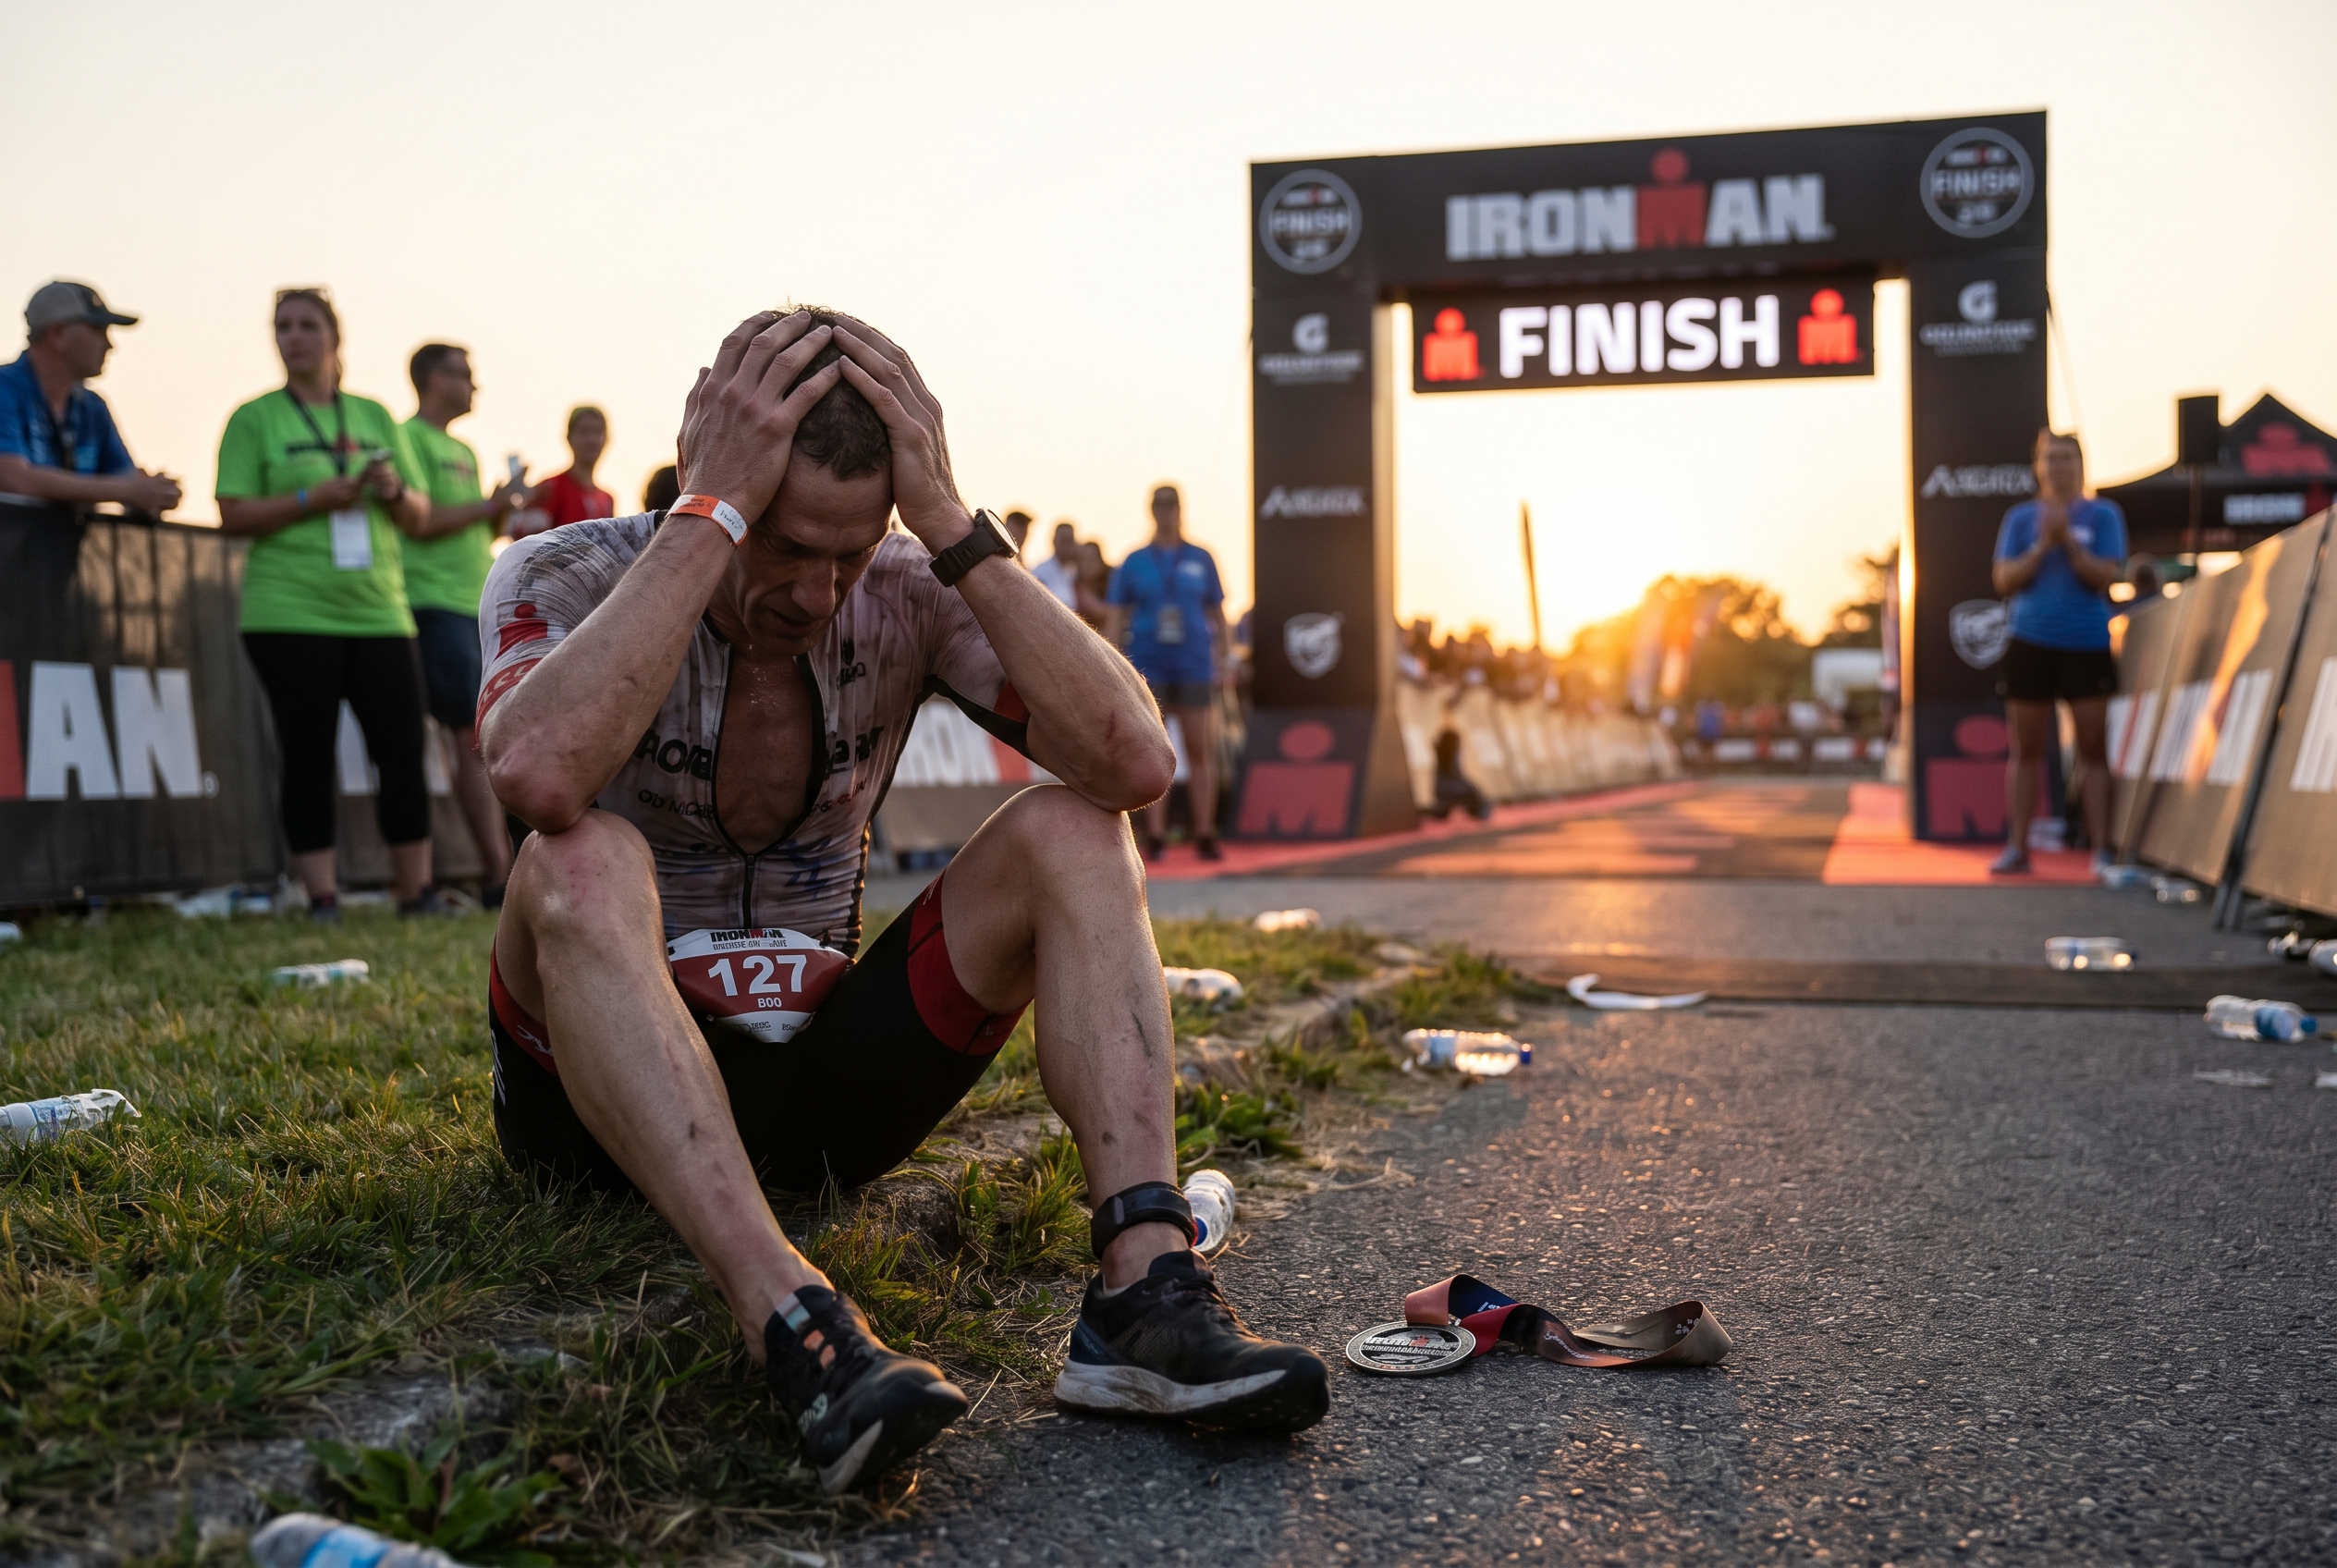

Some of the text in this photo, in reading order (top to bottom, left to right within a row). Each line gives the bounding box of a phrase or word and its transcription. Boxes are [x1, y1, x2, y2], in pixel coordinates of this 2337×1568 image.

[1445, 148, 1826, 262] IRONMAN
[1499, 293, 1780, 380] FINISH
[707, 954, 808, 997] 127
